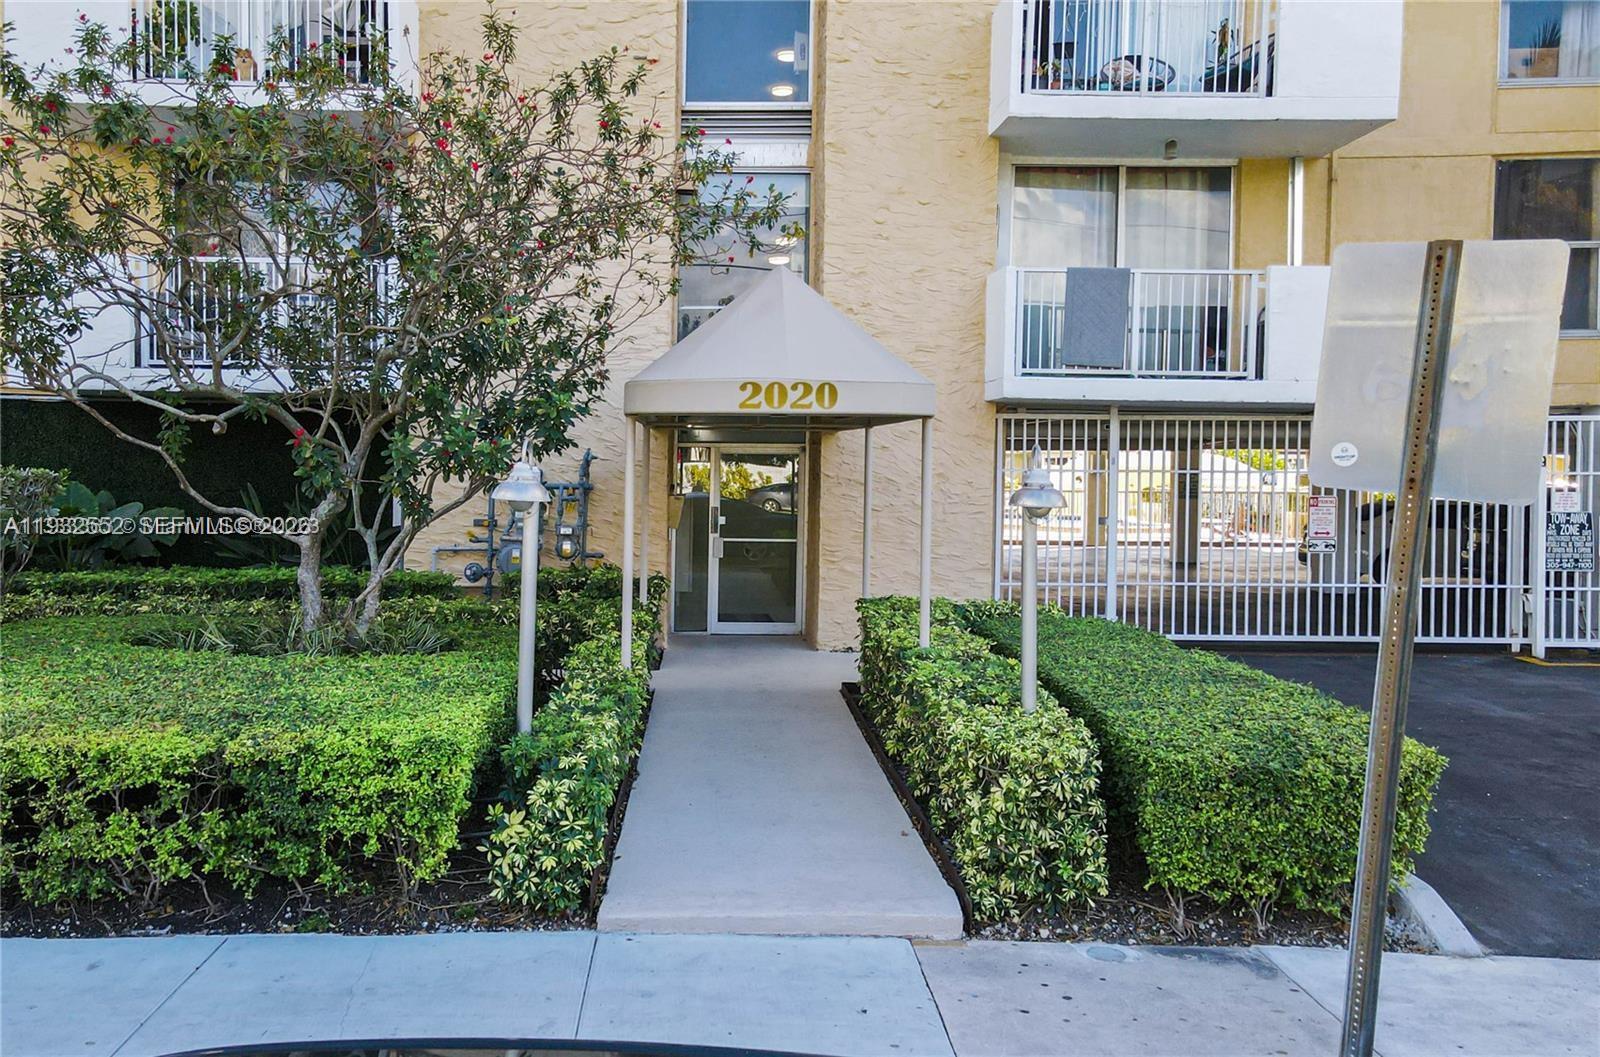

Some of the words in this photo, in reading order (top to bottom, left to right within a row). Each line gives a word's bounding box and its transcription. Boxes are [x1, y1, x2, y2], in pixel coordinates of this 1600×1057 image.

[739, 381, 838, 409] 2020
[1550, 513, 1588, 524] TOW-AWAY
[1560, 524, 1580, 535] ZONE
